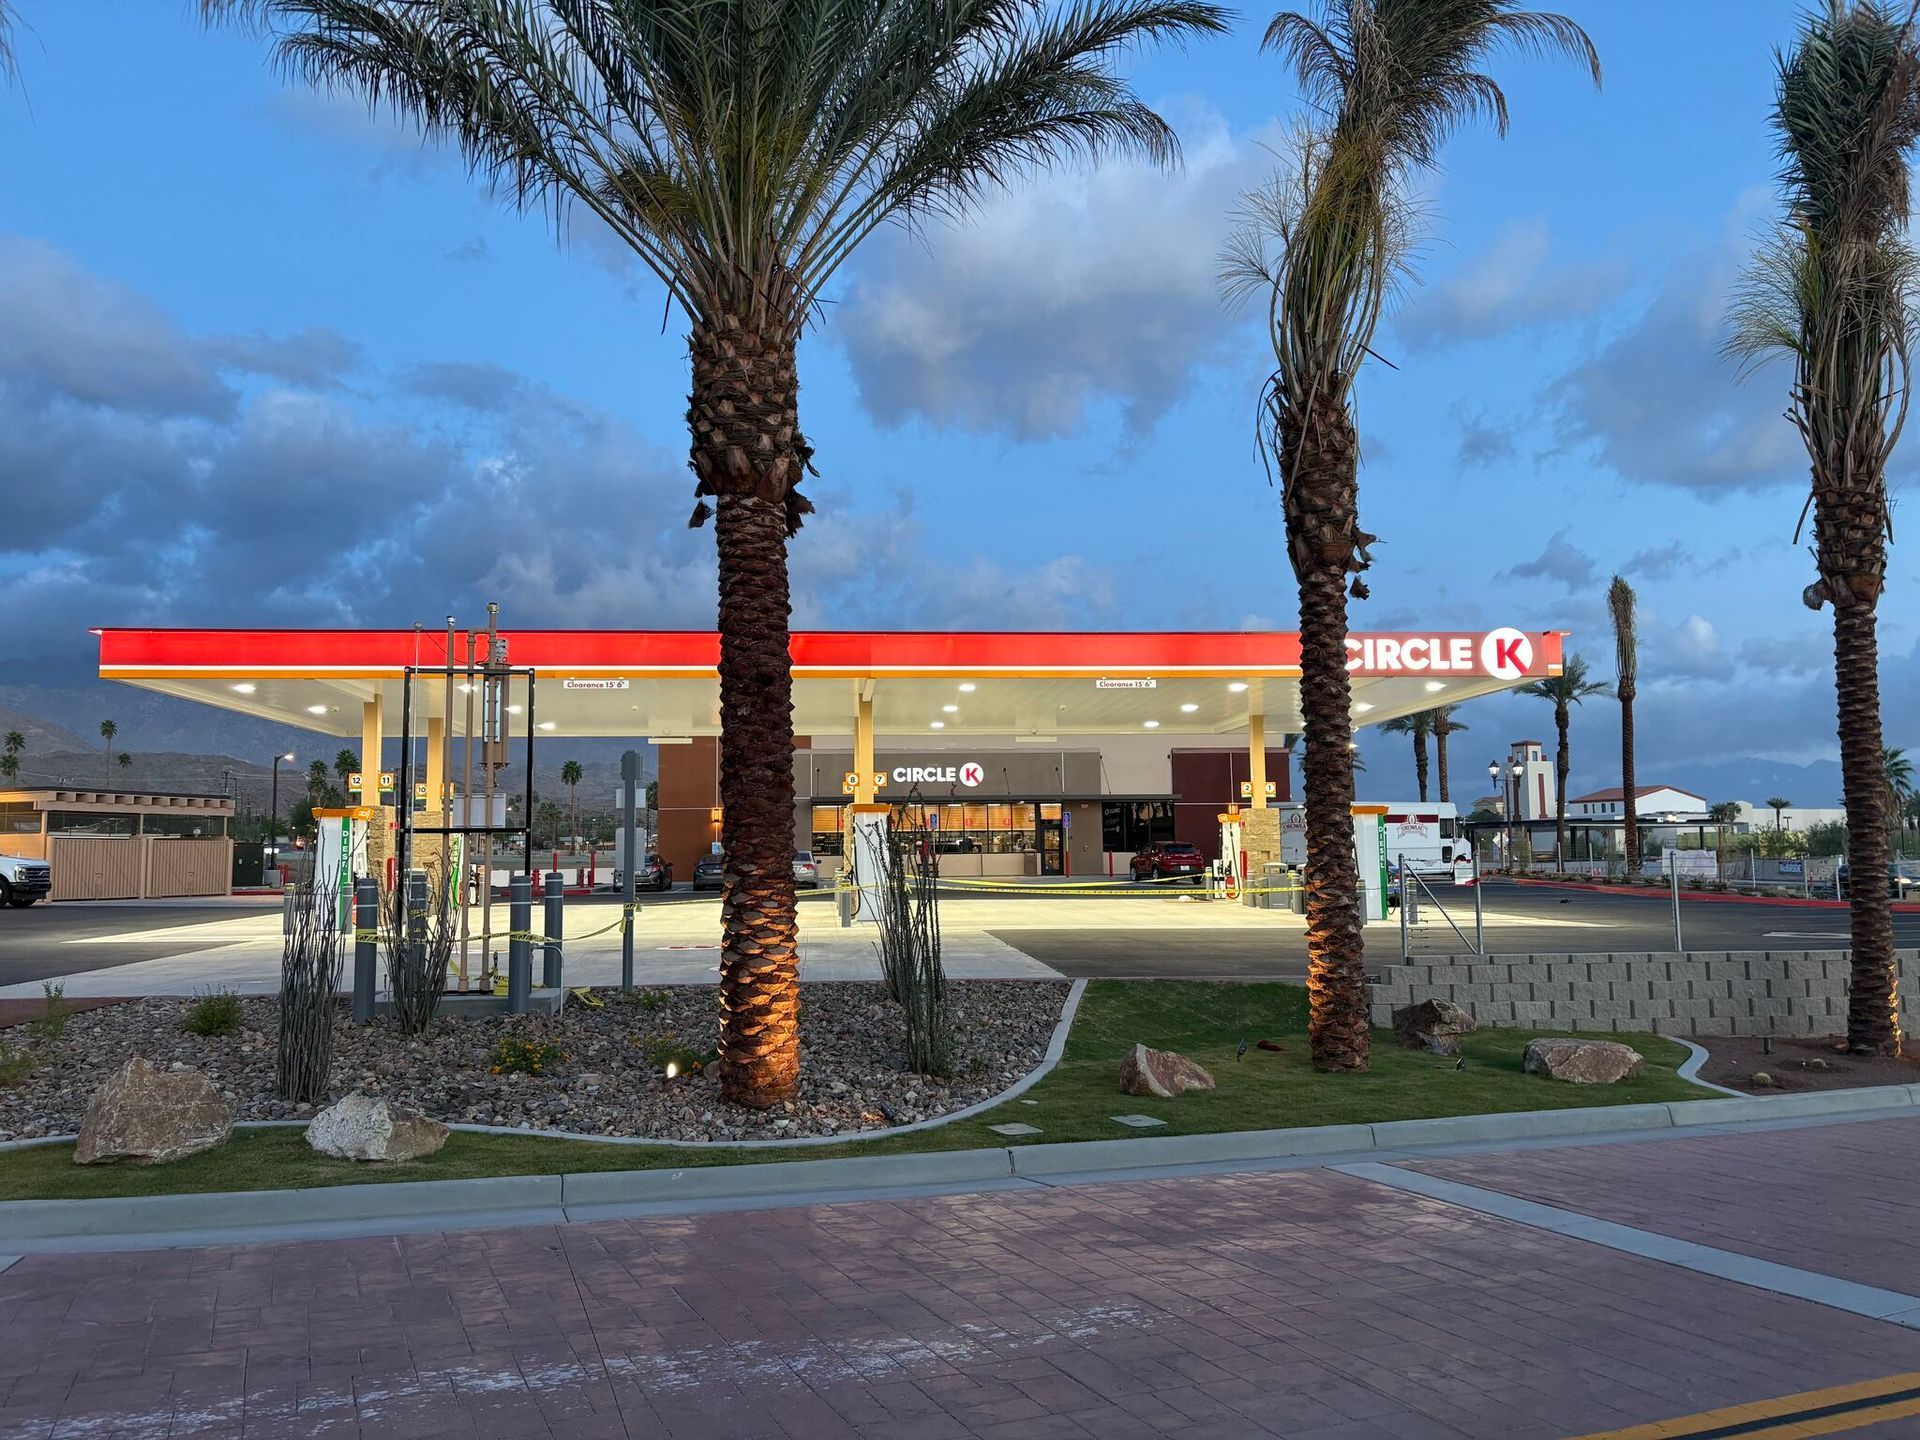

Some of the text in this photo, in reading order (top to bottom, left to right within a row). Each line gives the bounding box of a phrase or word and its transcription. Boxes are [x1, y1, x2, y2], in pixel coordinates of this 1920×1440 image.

[1344, 638, 1529, 675] CIRCLE K
[892, 767, 981, 785] CIRCLE K
